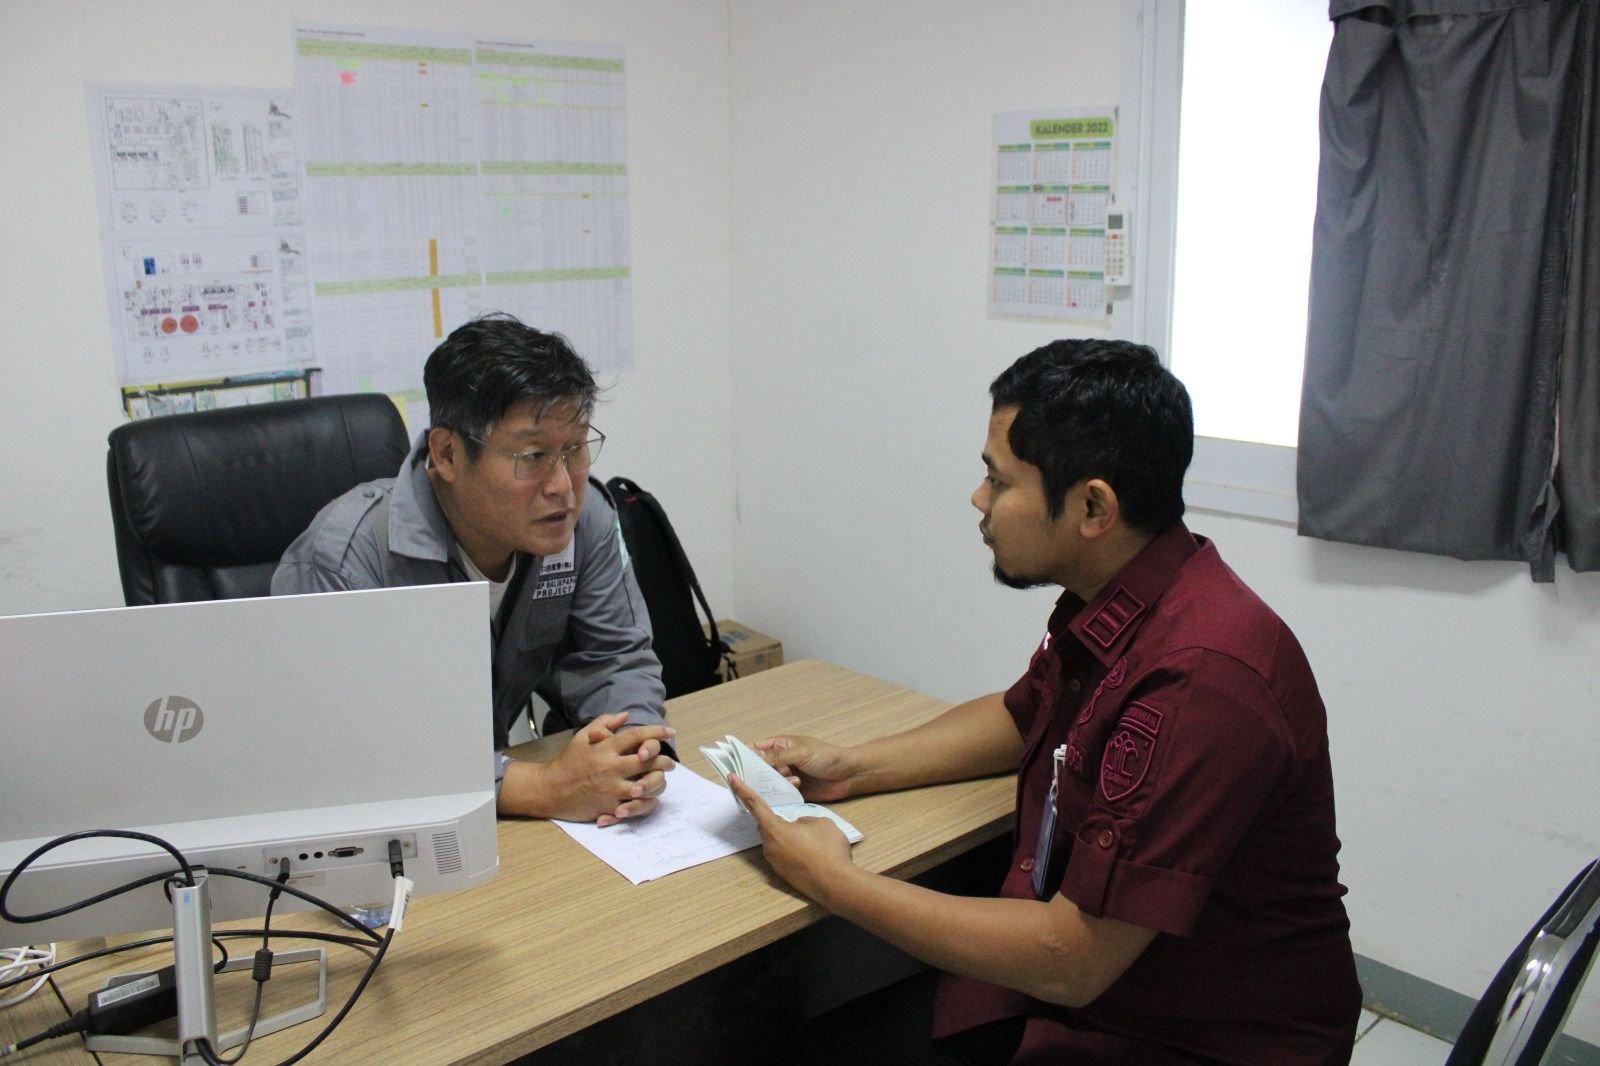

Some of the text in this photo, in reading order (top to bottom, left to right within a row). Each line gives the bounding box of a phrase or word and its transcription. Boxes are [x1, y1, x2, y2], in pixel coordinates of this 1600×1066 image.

[1036, 121, 1108, 135] KALENDER 2022
[536, 585, 572, 598] PROJECT
[153, 696, 197, 743] hp
